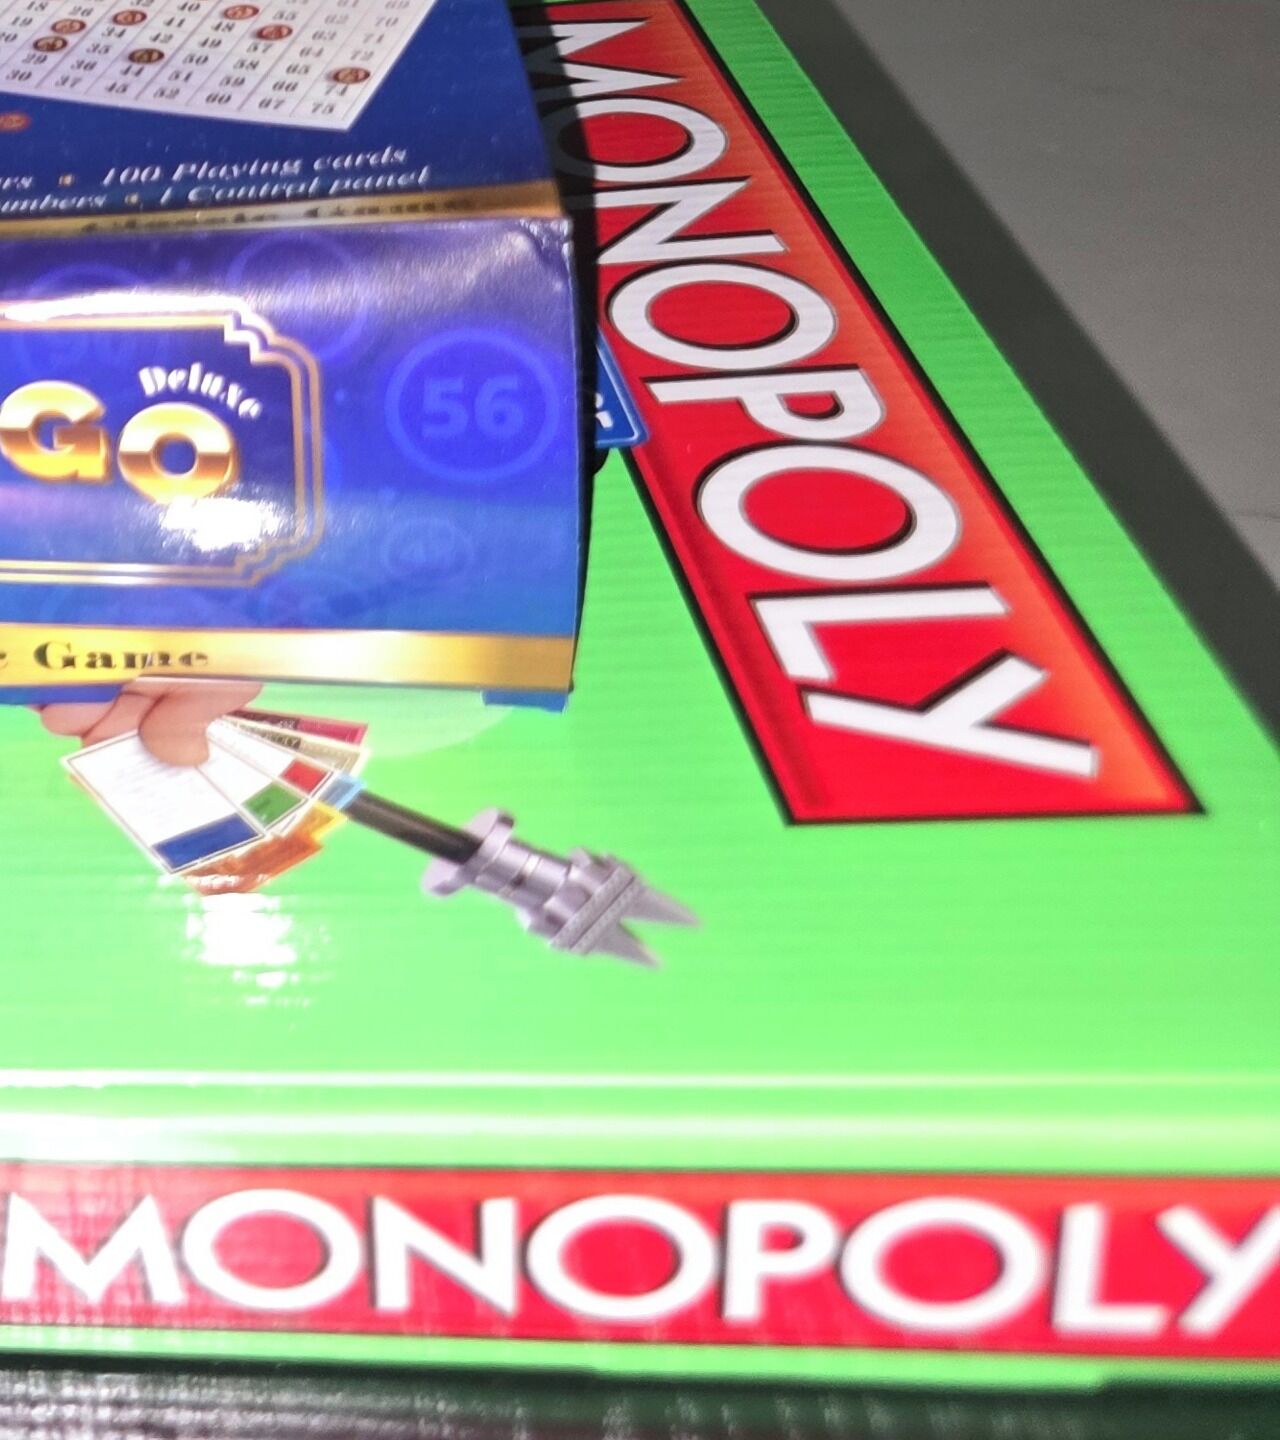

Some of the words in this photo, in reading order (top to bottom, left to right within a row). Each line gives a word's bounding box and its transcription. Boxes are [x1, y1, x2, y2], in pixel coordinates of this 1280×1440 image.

[102, 166, 160, 186] 100
[172, 158, 301, 183] Playing
[313, 146, 409, 172] cards
[188, 177, 319, 203] Control
[328, 165, 431, 195] panel
[139, 363, 263, 420] Deluxe
[421, 374, 528, 441] 56
[514, 18, 1100, 780] MONOPOLY
[34, 641, 209, 670] Game
